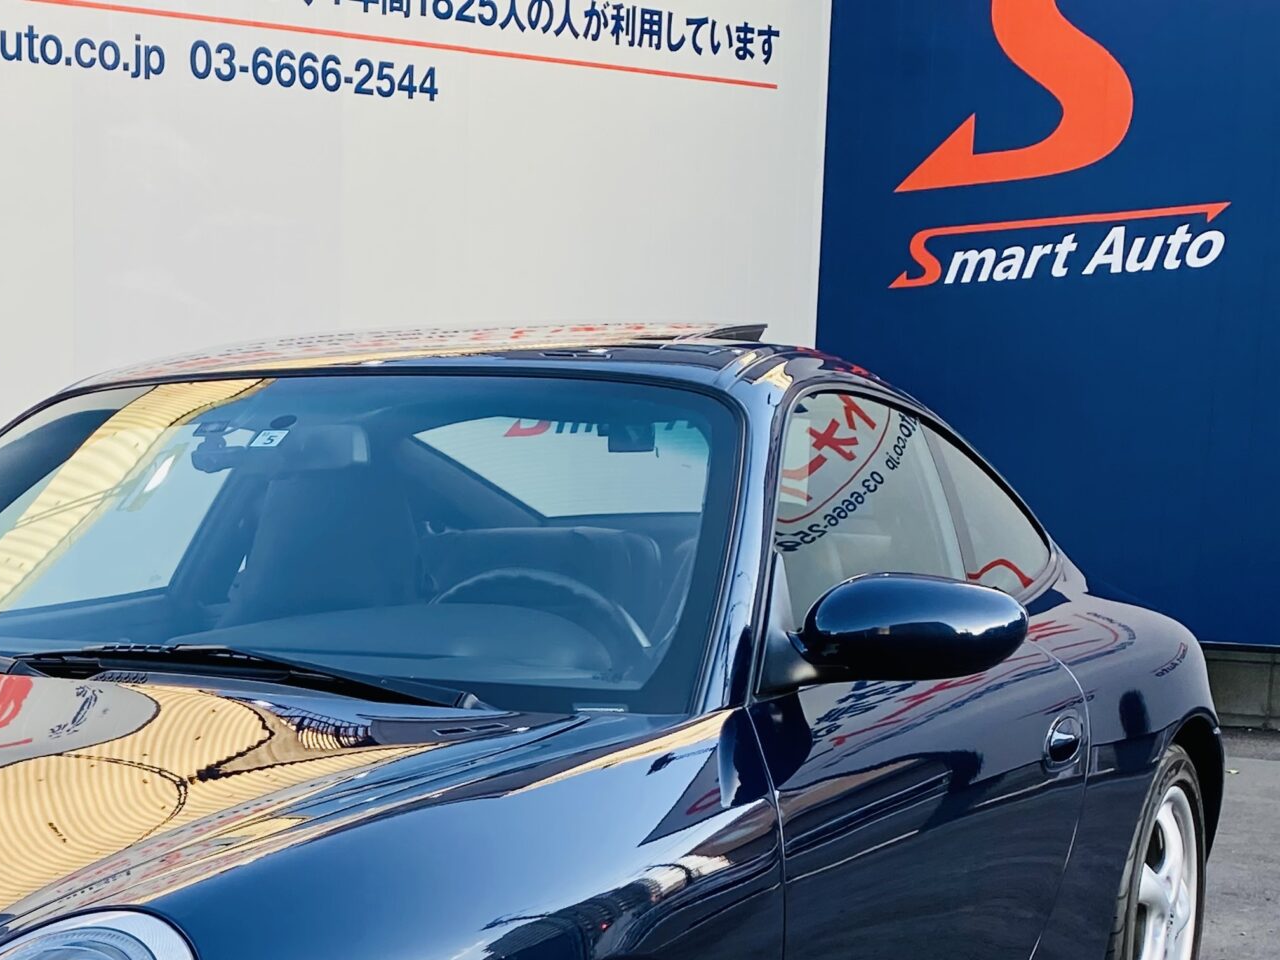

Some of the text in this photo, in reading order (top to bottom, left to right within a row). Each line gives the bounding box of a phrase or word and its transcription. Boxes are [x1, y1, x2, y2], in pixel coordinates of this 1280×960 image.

[190, 40, 439, 101] 03-6666-2544
[888, 223, 1226, 289] Smart Auto
